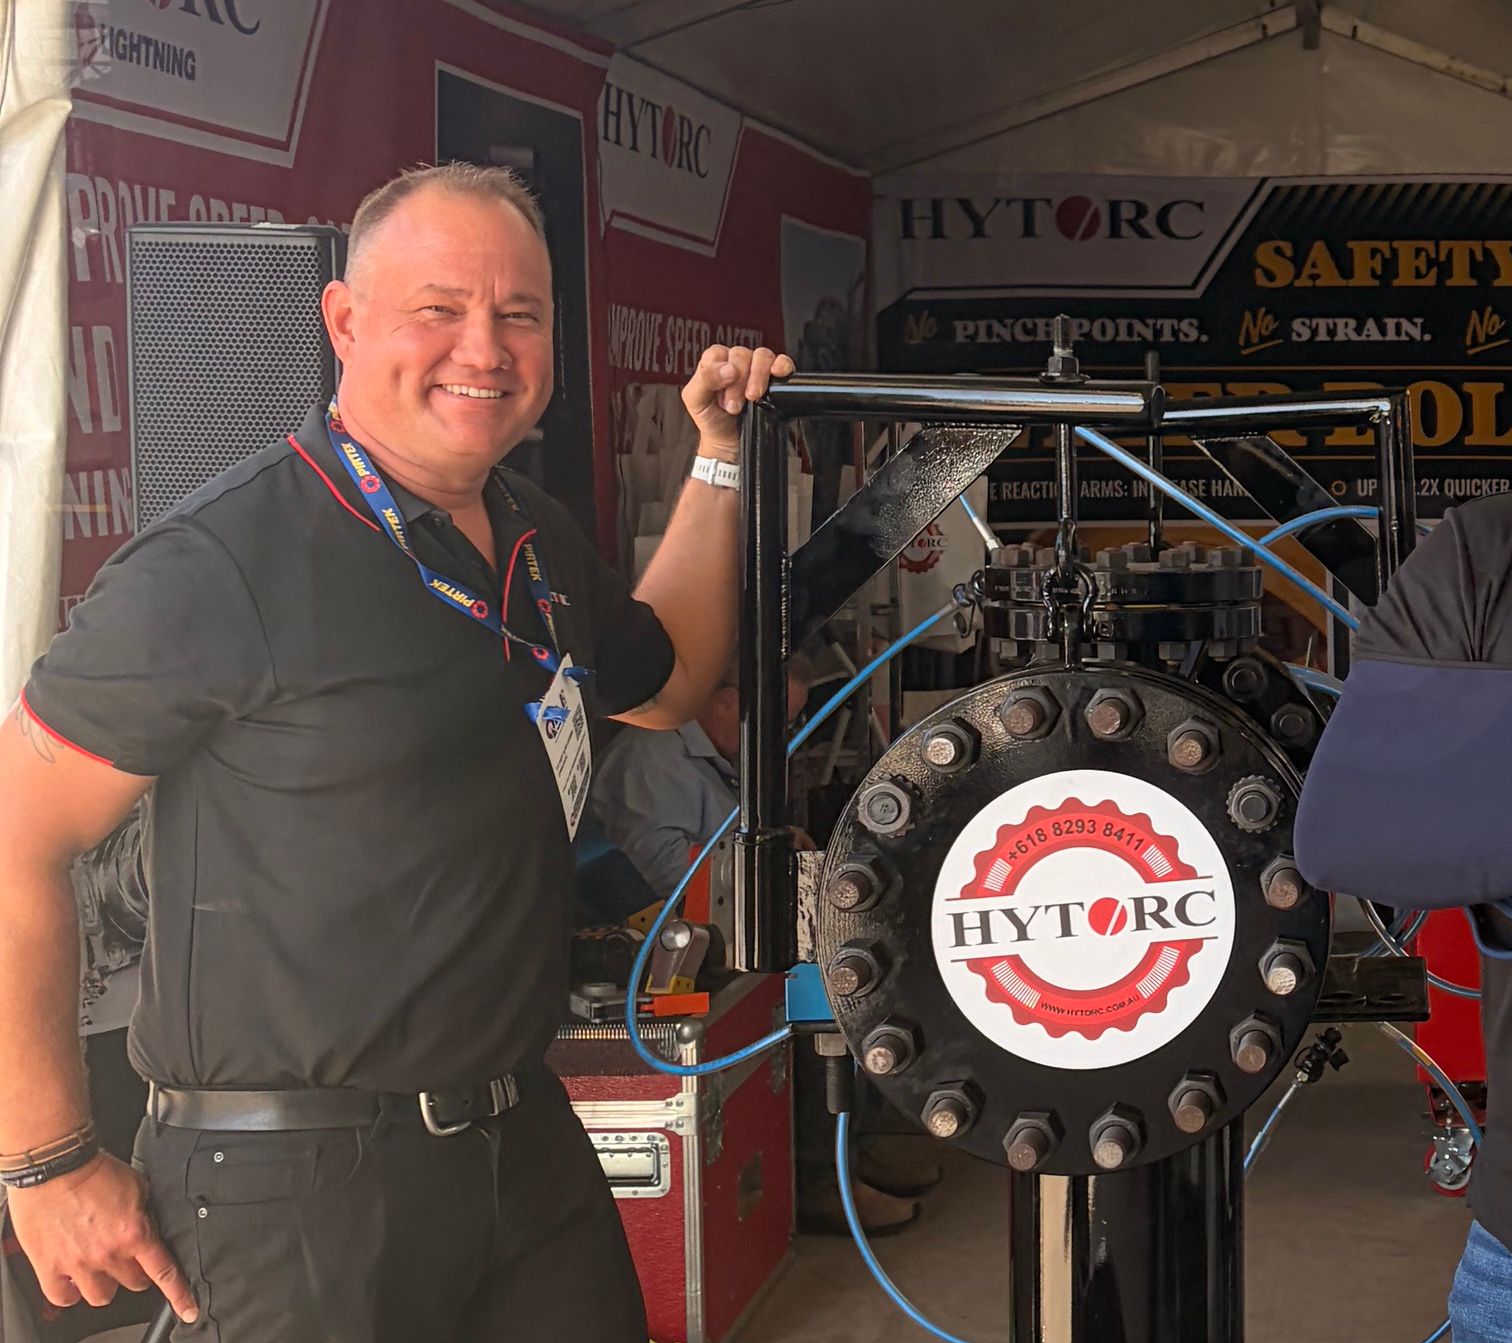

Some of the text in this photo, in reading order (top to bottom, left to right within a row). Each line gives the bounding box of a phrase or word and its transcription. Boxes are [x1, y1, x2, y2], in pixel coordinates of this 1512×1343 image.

[602, 82, 712, 179] HYTORC
[900, 196, 1205, 241] HYTORC
[1071, 317, 1208, 344] POINTS.
[1239, 306, 1284, 355] No
[1290, 316, 1432, 343] STRAIN.
[1465, 306, 1510, 355] No
[1002, 480, 1060, 500] REACTI
[1080, 480, 1128, 498] ARMS:
[1357, 478, 1377, 497] UP
[430, 578, 476, 608] PIRTEK
[1008, 818, 1144, 862] +618 8293 8411
[945, 888, 1218, 949] HYTORC
